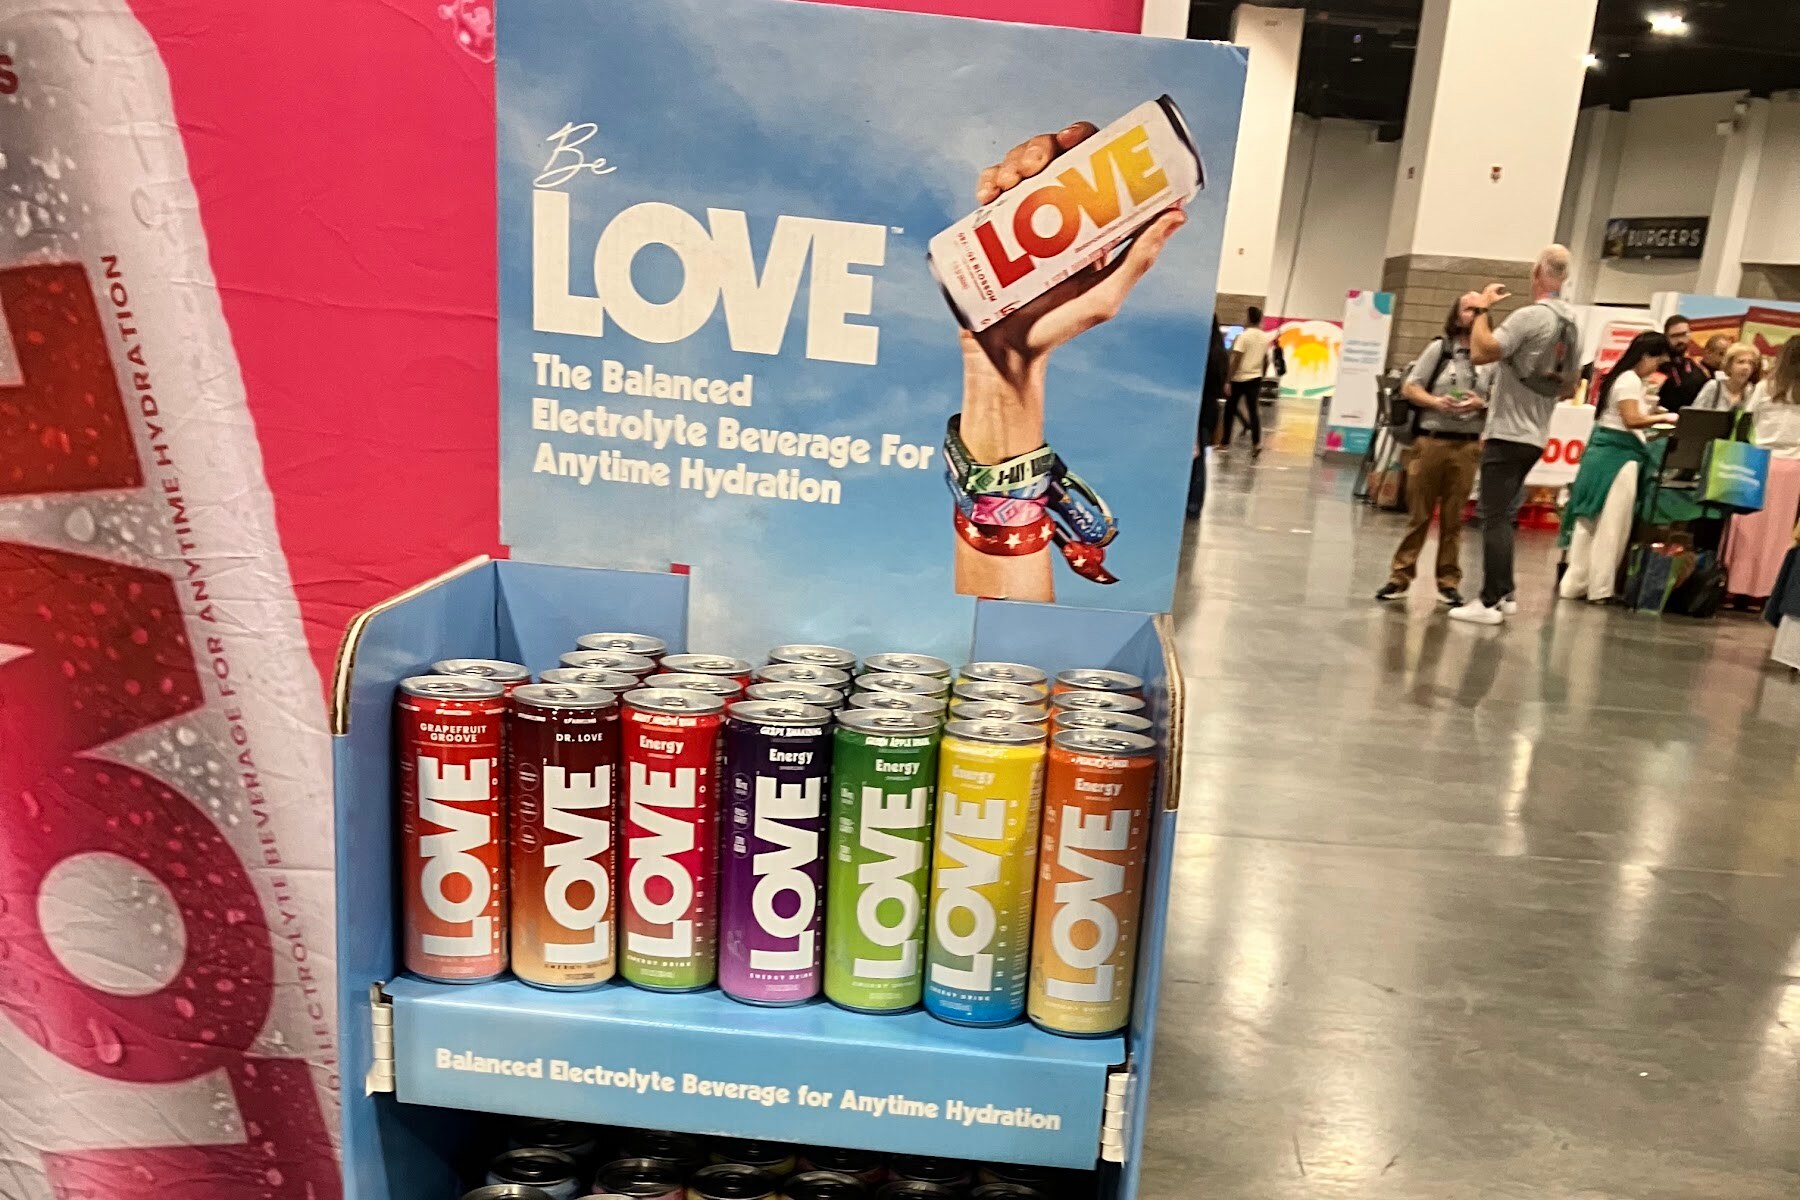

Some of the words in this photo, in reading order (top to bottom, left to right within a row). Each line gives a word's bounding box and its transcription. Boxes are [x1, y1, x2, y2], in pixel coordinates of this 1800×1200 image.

[533, 121, 617, 187] Be
[974, 124, 1169, 288] LOVE
[532, 190, 886, 364] LOVE
[100, 254, 174, 467] HYDRATION
[532, 353, 592, 391] The
[602, 360, 752, 406] Balanced
[532, 398, 707, 449] Electrolyte
[718, 418, 869, 466] Beverage
[880, 433, 934, 470] For
[533, 442, 670, 491] Anytime
[681, 458, 842, 504] Hydration
[160, 474, 220, 623] ANYTIME
[206, 635, 238, 698] FOR
[223, 705, 283, 866] BEVERAGE
[420, 723, 487, 733] GRAPEFRUIT
[430, 733, 478, 743] GROOVE
[556, 733, 576, 742] DR.
[578, 732, 603, 742] LOVE
[639, 735, 684, 755] Energy
[769, 748, 814, 765] Energy
[875, 758, 920, 776] Energy
[418, 756, 491, 956] LOVE
[543, 765, 611, 963] LOVE
[628, 762, 697, 958] LOVE
[750, 775, 822, 970] LOVE
[852, 786, 928, 979] LOVE
[931, 792, 1007, 991] LOVE
[1046, 805, 1132, 1002] LOVE
[435, 1047, 543, 1078] Balanced
[549, 1059, 675, 1094] Electrolyte
[682, 1073, 790, 1106] Beverage
[798, 1084, 833, 1108] for
[840, 1089, 939, 1118] Anytime
[946, 1100, 1062, 1131] Hydration
